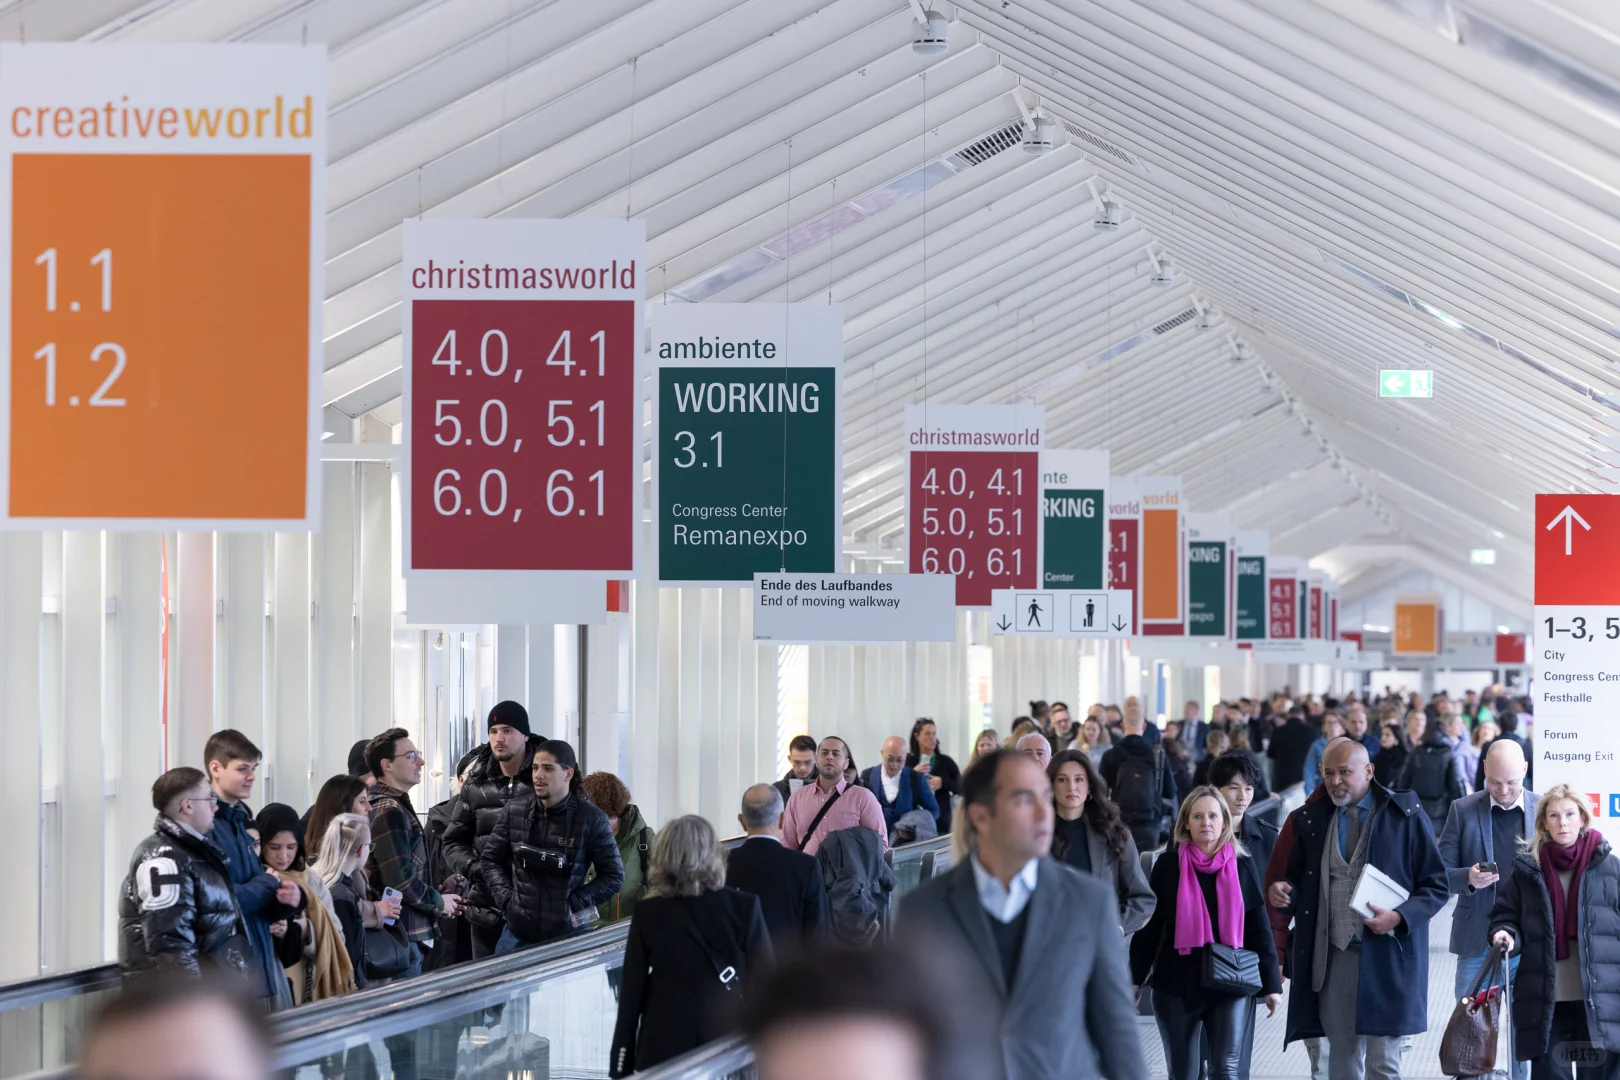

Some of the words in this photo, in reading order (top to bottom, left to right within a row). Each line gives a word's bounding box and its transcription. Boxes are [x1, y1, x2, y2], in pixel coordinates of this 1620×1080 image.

[11, 95, 313, 139] creativeworld
[35, 247, 113, 312] 1.1
[412, 259, 636, 290] christmasworld
[431, 328, 523, 383] 4.0,
[545, 329, 606, 377] 4.1
[658, 336, 777, 359] ambiente
[34, 342, 127, 407] 1.2
[673, 382, 820, 413] WORKING
[433, 398, 523, 453] 5.0,
[546, 399, 605, 447] 5.1
[909, 427, 1040, 446] christmasworld
[673, 430, 725, 469] 3.1
[433, 468, 522, 523] 6.0,
[546, 468, 604, 517] 6.1
[921, 467, 975, 500] 4.0,
[987, 468, 1022, 496] 4.1
[672, 503, 737, 520] Congress
[741, 503, 788, 517] Center
[922, 507, 974, 540] 5.0,
[987, 508, 1022, 536] 5.1
[673, 524, 807, 551] Remanexpo
[922, 547, 974, 580] 6.0,
[987, 547, 1022, 576] 6.1
[1044, 571, 1075, 582] Center
[760, 579, 791, 591] Ende
[795, 579, 817, 591] des
[821, 579, 893, 591] Laufbandes
[760, 594, 783, 607] End
[786, 594, 799, 607] of
[802, 595, 845, 609] moving
[849, 595, 900, 610] walkway
[1605, 617, 1620, 640] 5
[1544, 649, 1566, 662] City
[1544, 671, 1595, 684] Congress
[1544, 692, 1593, 703] Festhalle
[1544, 729, 1578, 740] Forum
[1543, 750, 1591, 763] Ausgang
[1595, 750, 1614, 761] Exit
